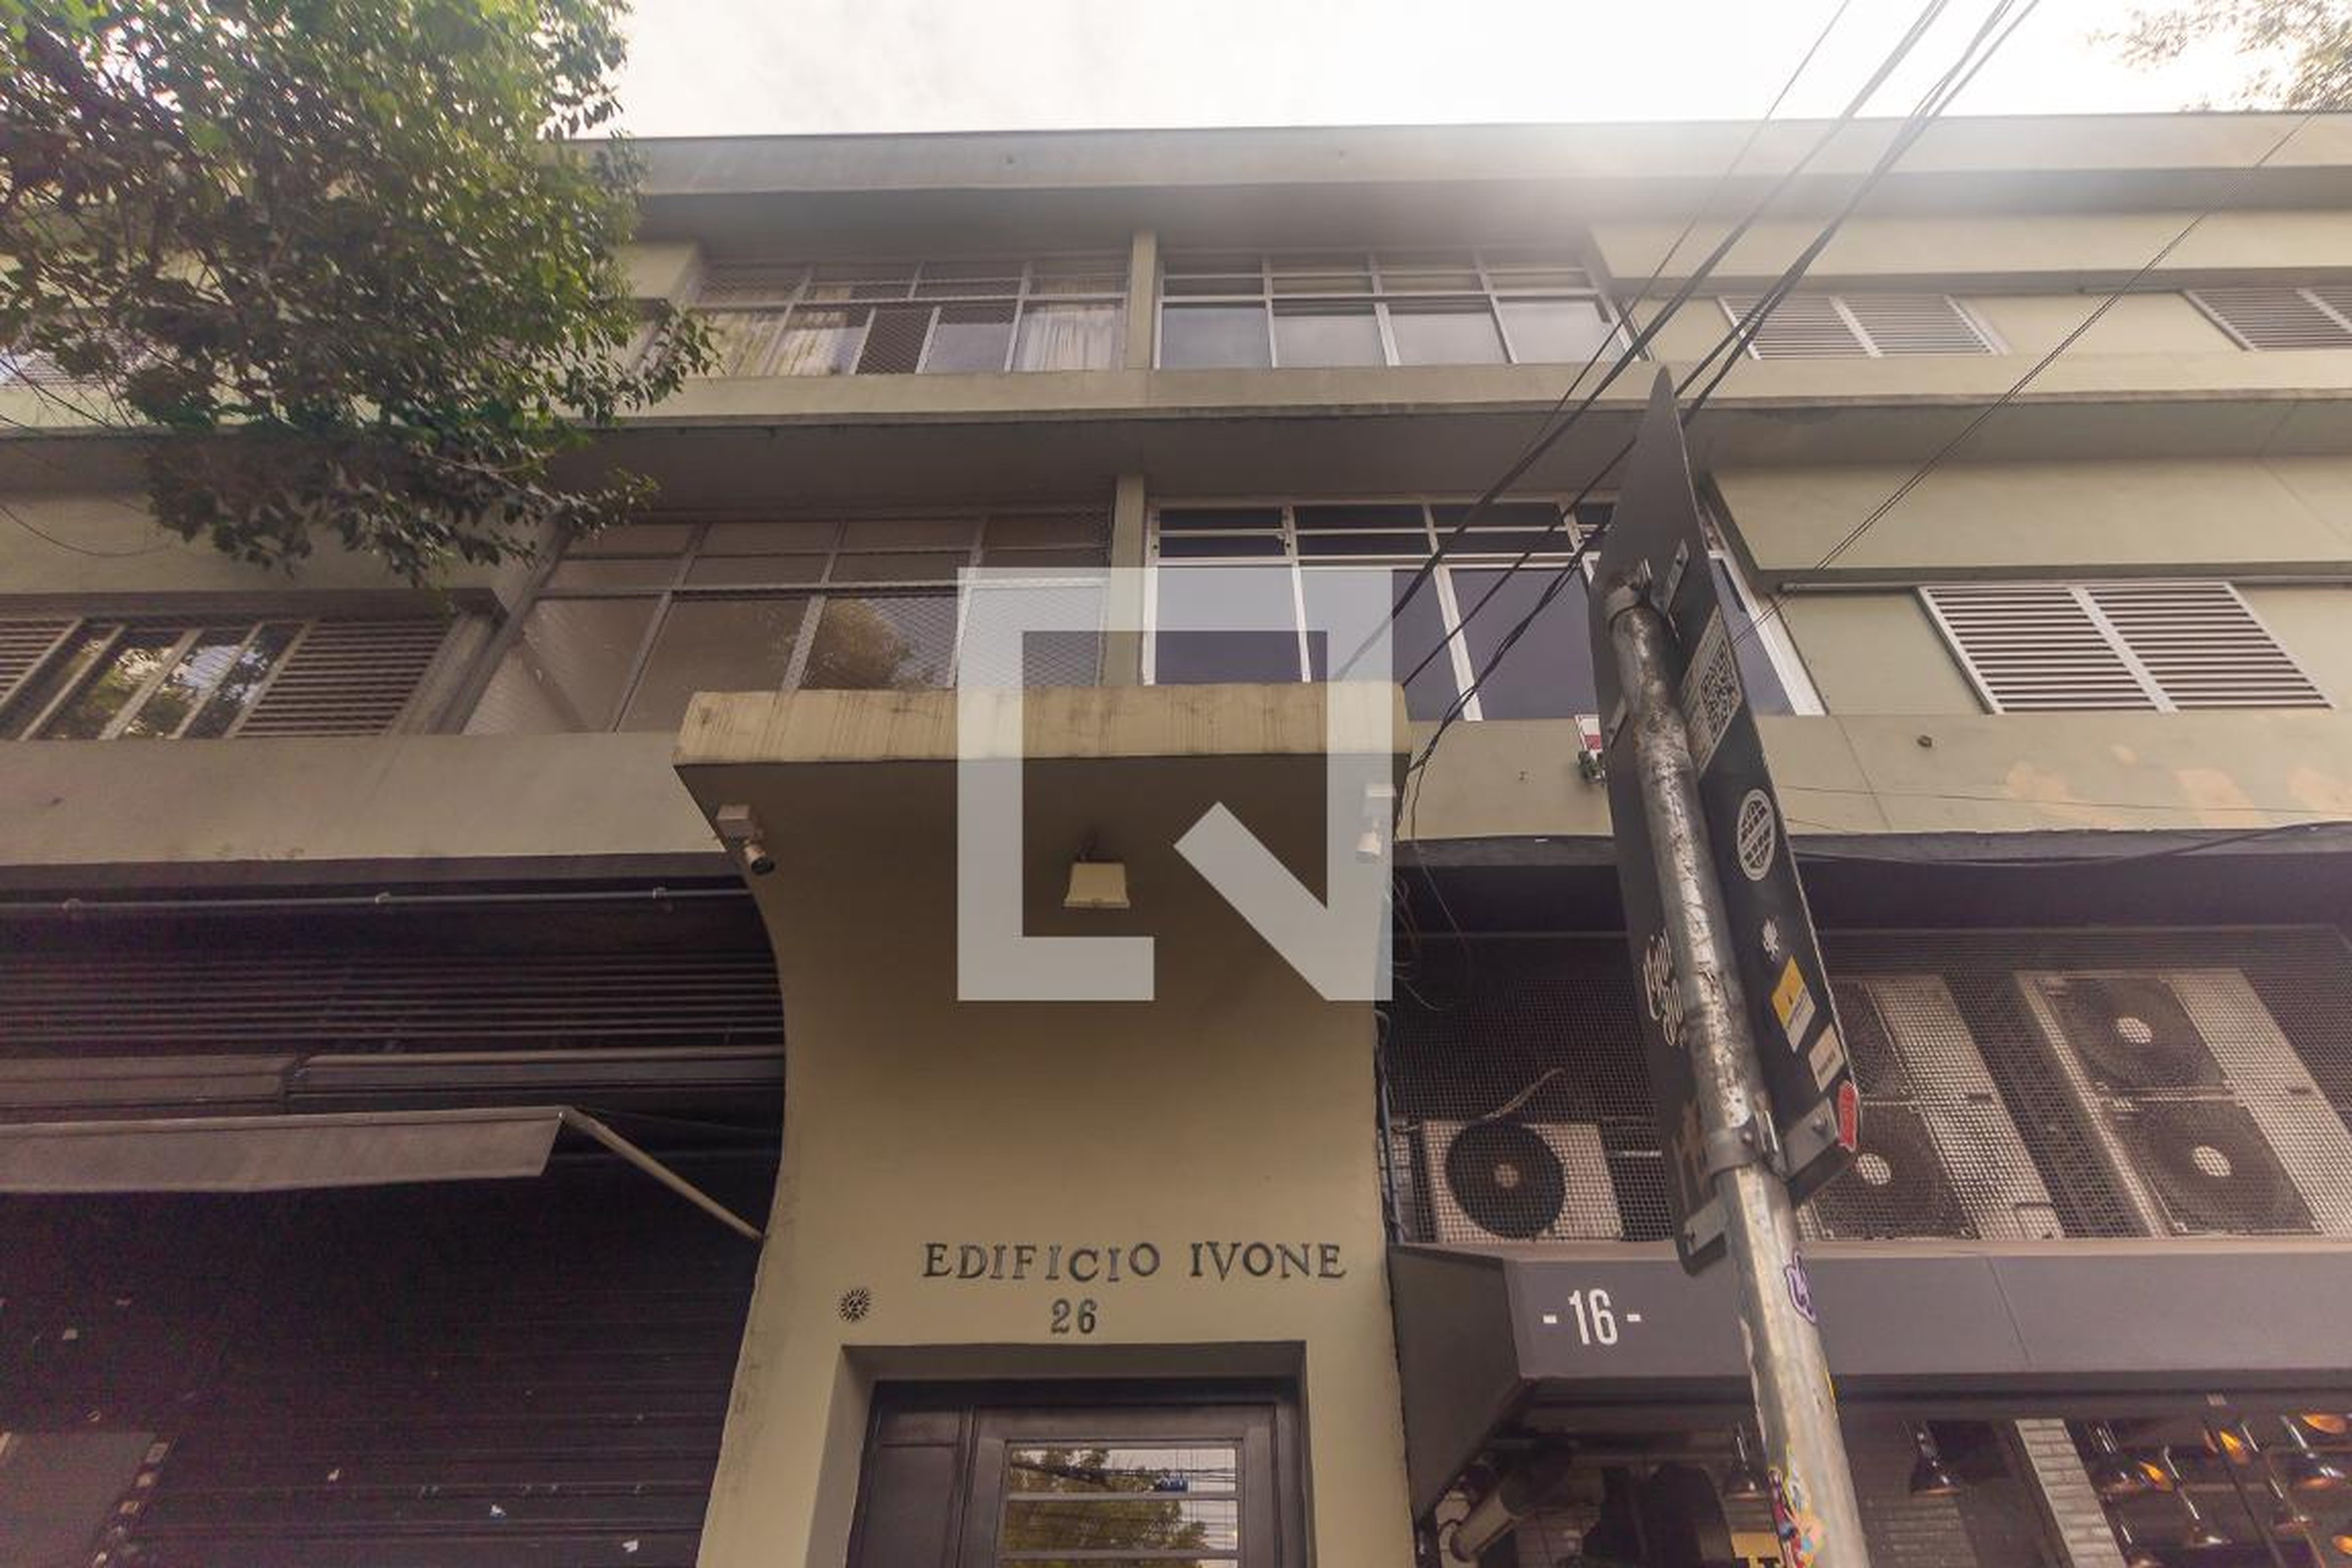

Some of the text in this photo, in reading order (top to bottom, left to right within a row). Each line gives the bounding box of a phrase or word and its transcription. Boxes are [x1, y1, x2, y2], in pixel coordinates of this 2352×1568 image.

[922, 1241, 1347, 1283] EDIFICIO IVONE
[1050, 1298, 1098, 1335] 26
